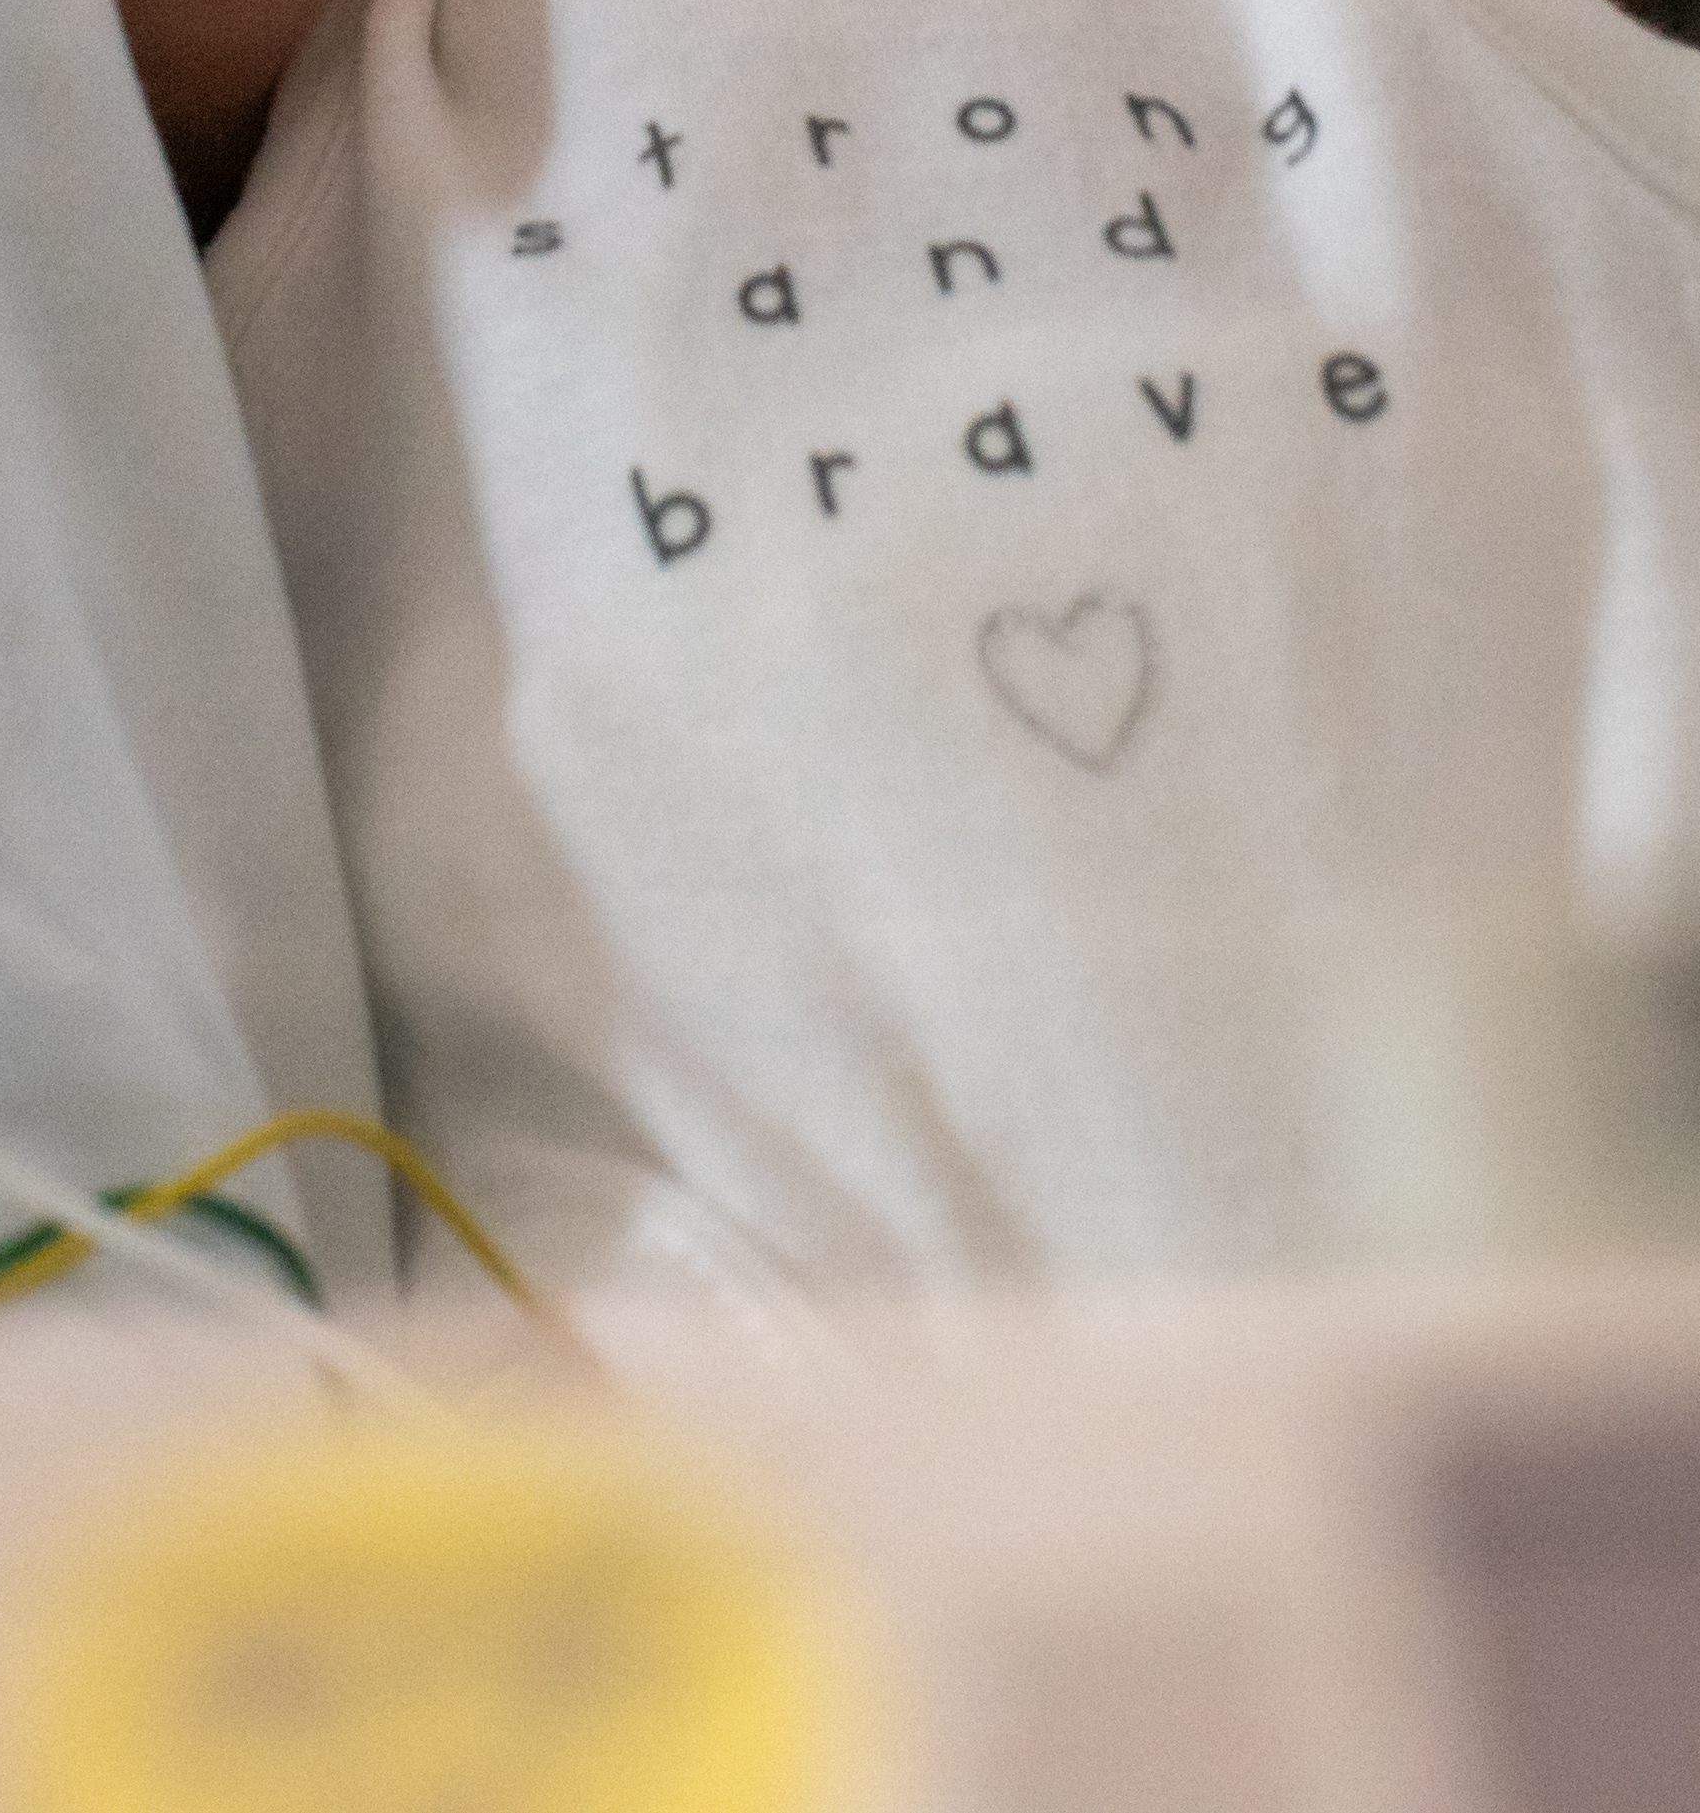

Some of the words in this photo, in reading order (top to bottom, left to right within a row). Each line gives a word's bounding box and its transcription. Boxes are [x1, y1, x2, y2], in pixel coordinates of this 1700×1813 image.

[509, 87, 1320, 260] strong
[732, 189, 1180, 329] and
[626, 348, 1391, 571] brave
